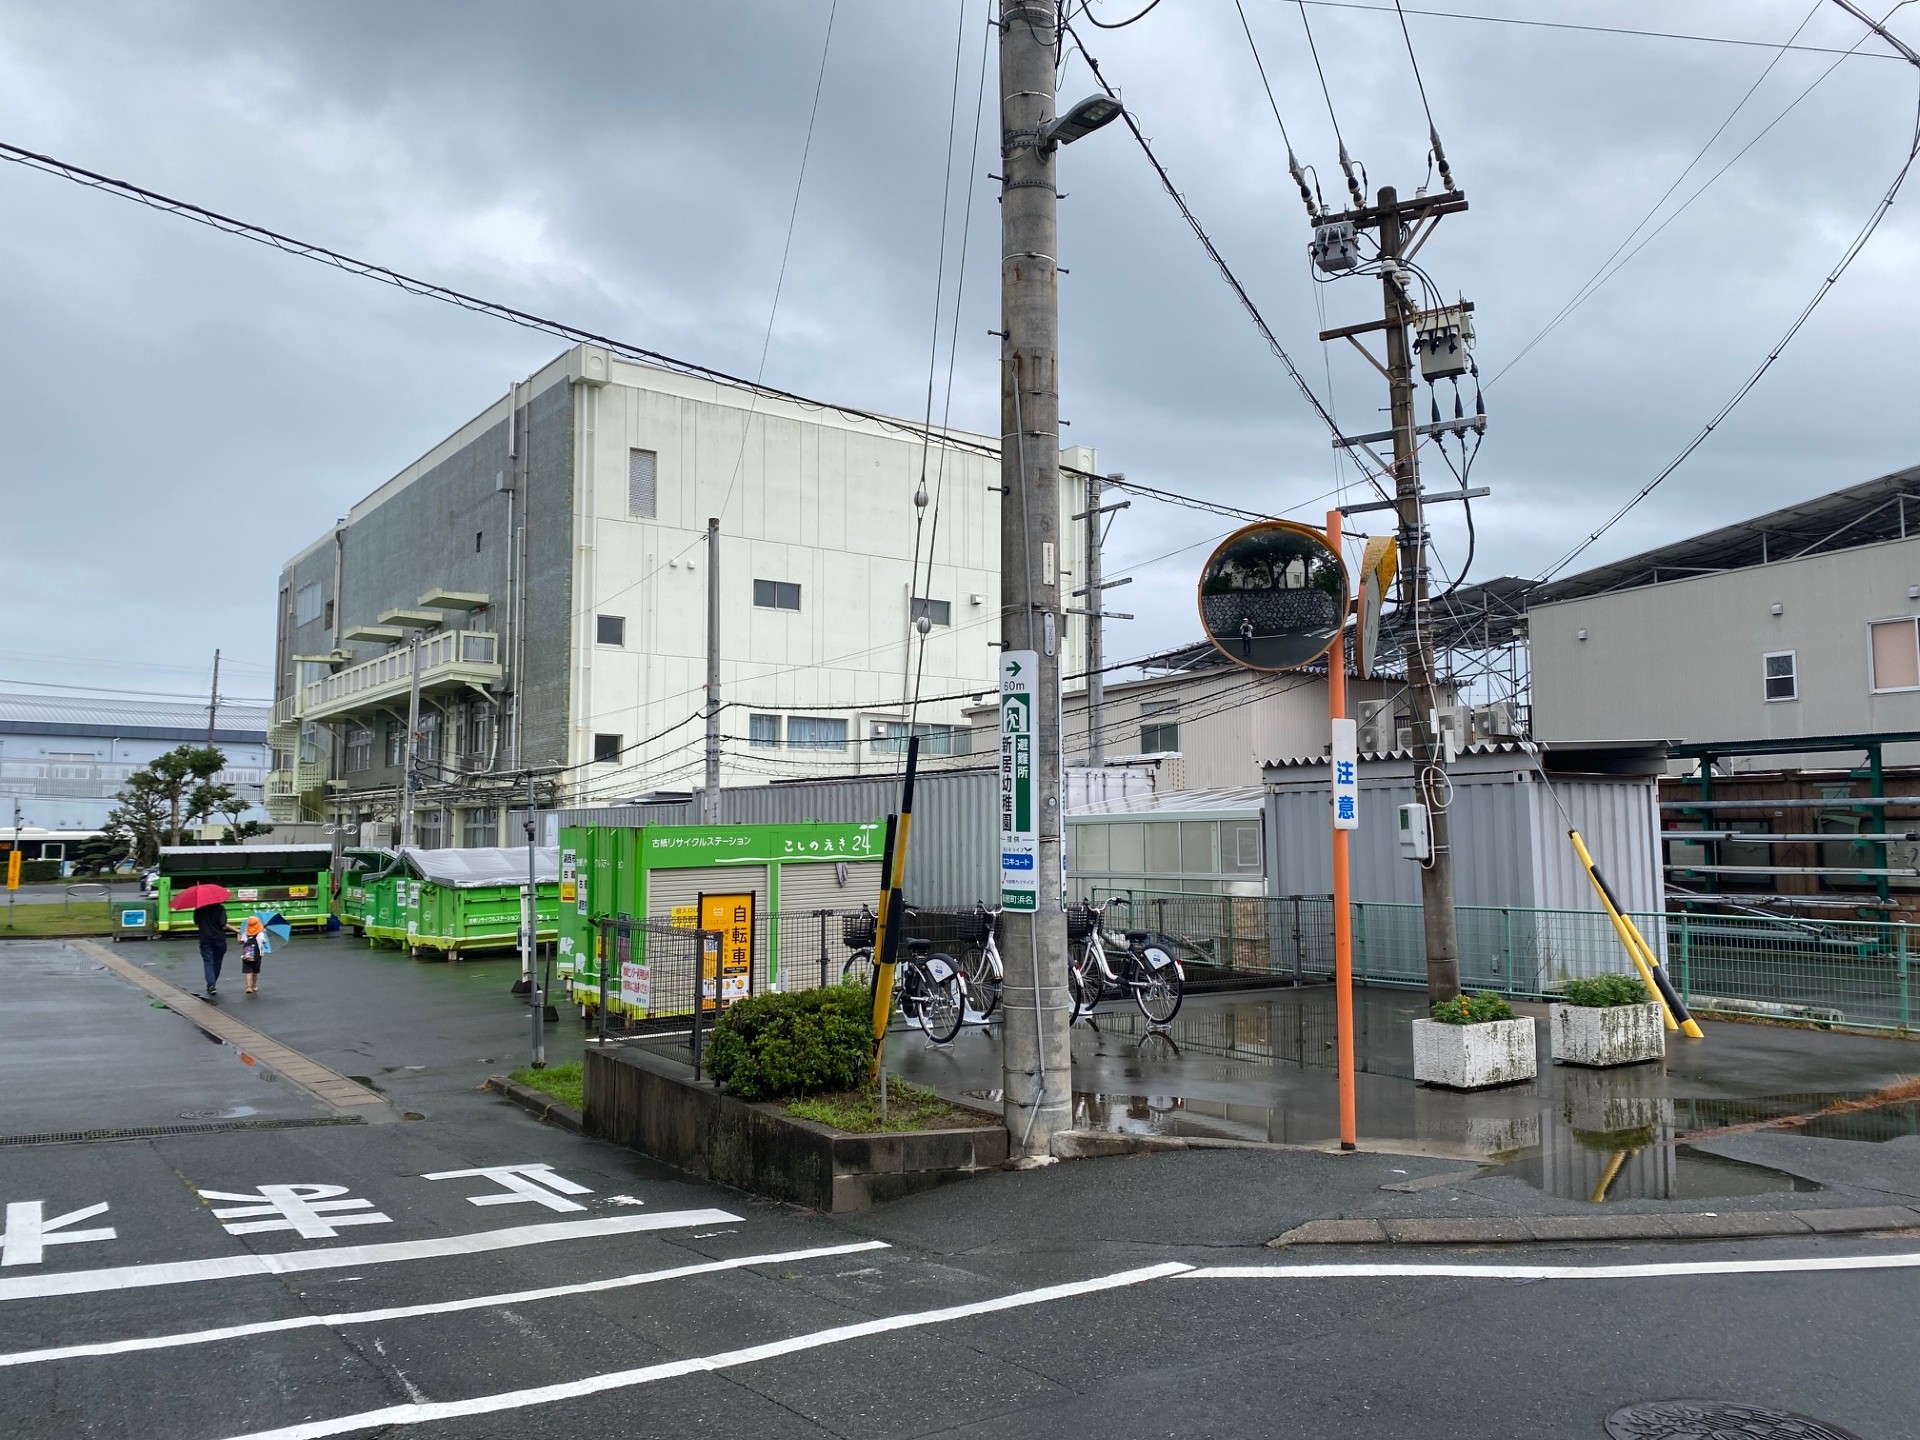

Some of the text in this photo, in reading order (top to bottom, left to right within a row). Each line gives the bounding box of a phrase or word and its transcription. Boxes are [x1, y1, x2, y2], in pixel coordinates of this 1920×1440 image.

[1004, 681, 1025, 691] 60m
[1017, 738, 1028, 779] 避難所
[1002, 736, 1012, 832] 新居幼稚園
[1337, 761, 1354, 819] 注意
[652, 836, 752, 849] 古紙リサイクルステーション
[731, 904, 748, 966] 自転車
